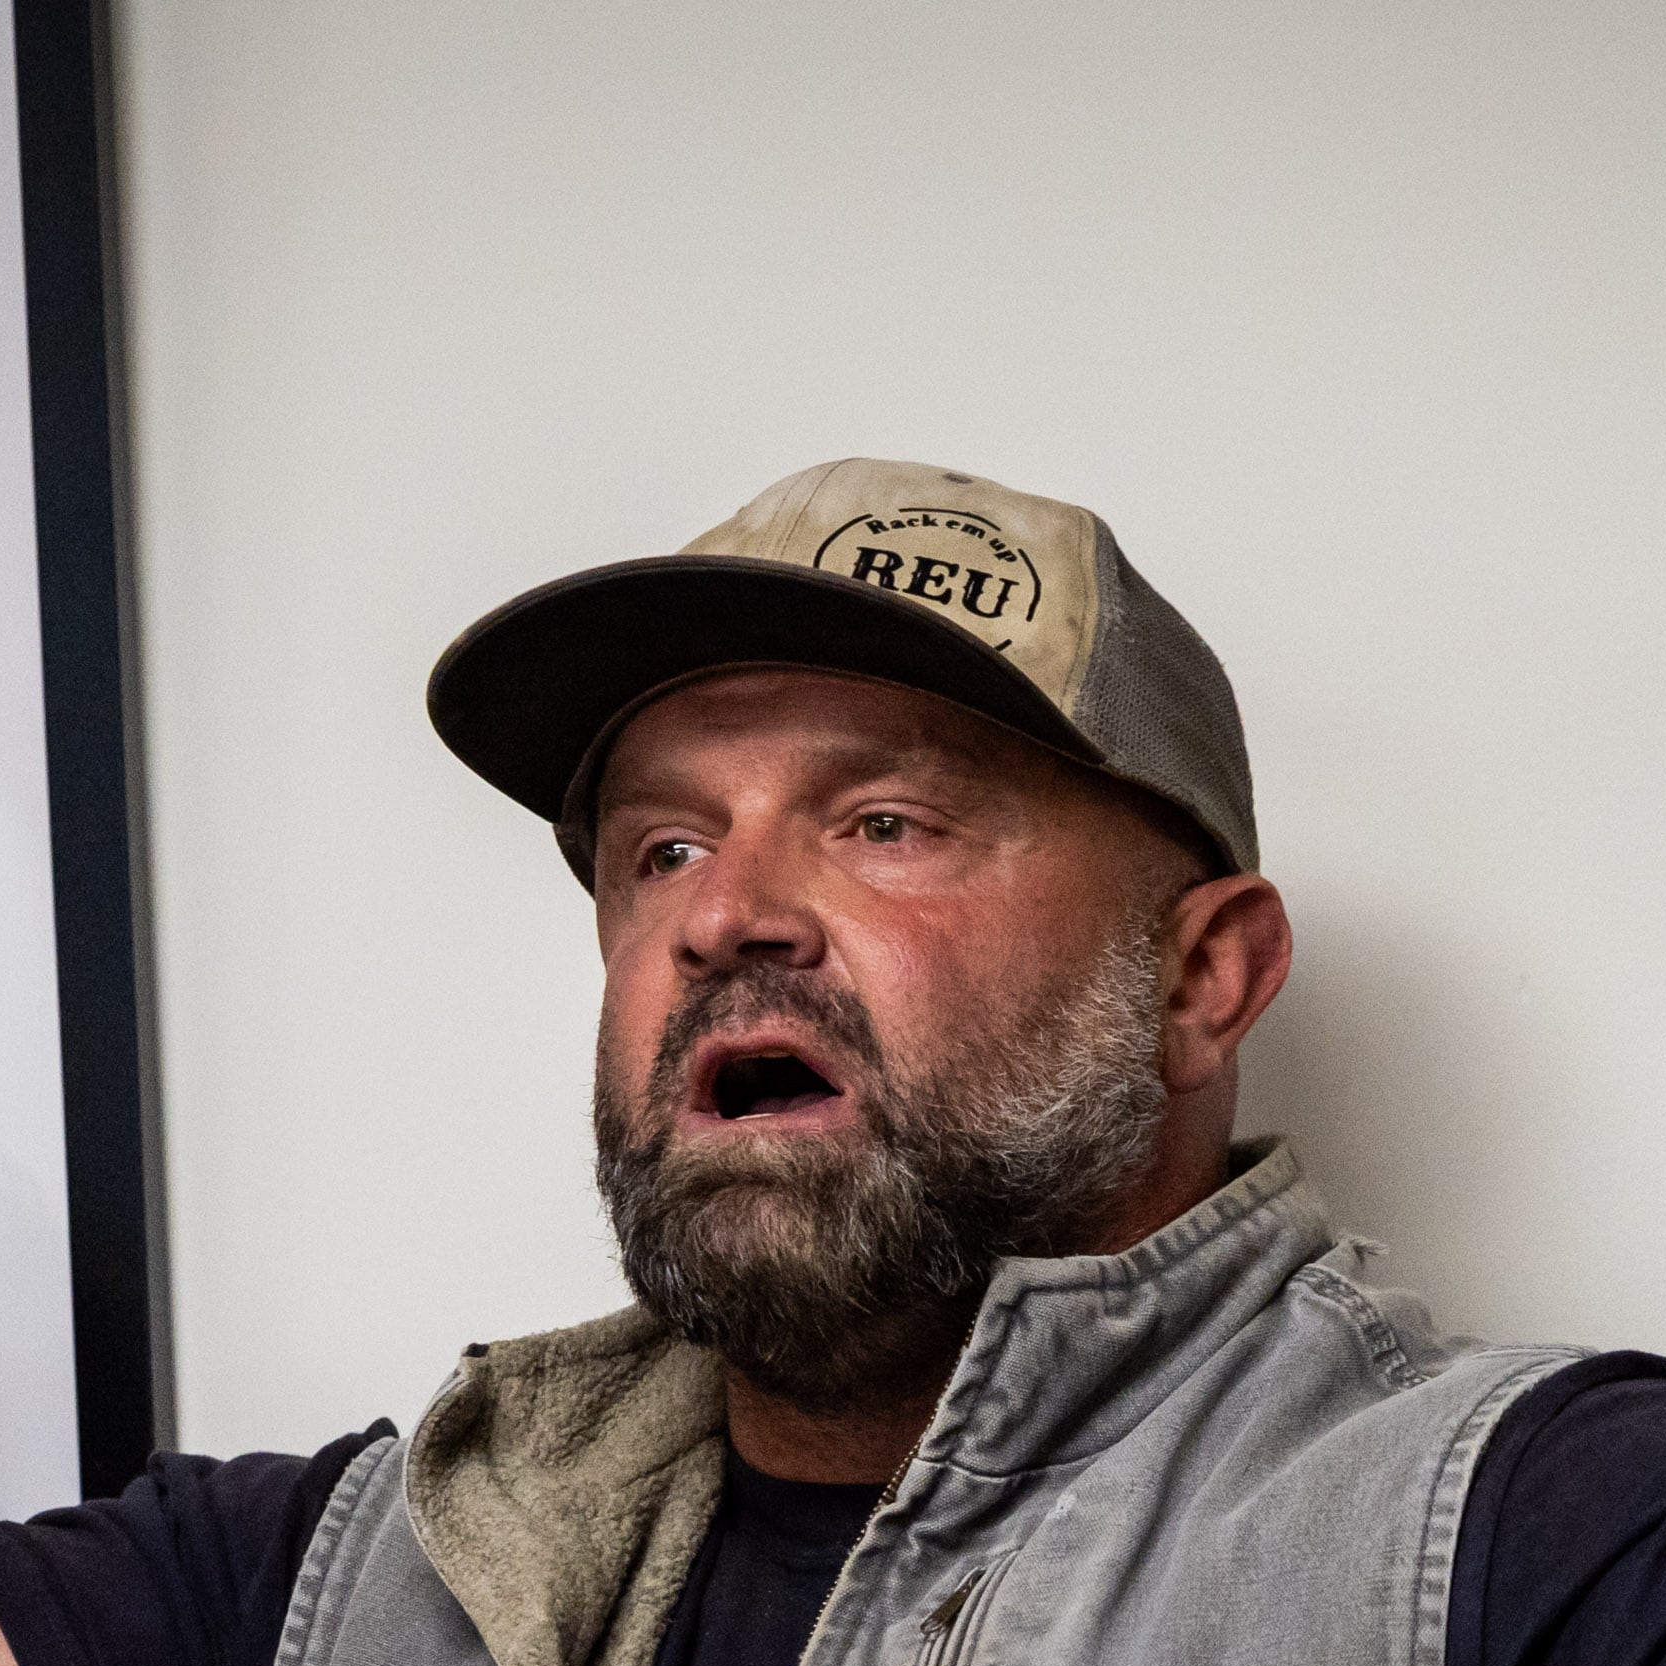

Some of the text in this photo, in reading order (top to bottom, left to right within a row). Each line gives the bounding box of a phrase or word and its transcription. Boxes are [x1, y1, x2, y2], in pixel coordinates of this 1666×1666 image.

[864, 513, 1018, 563] Rack em up
[851, 546, 1021, 619] REU
